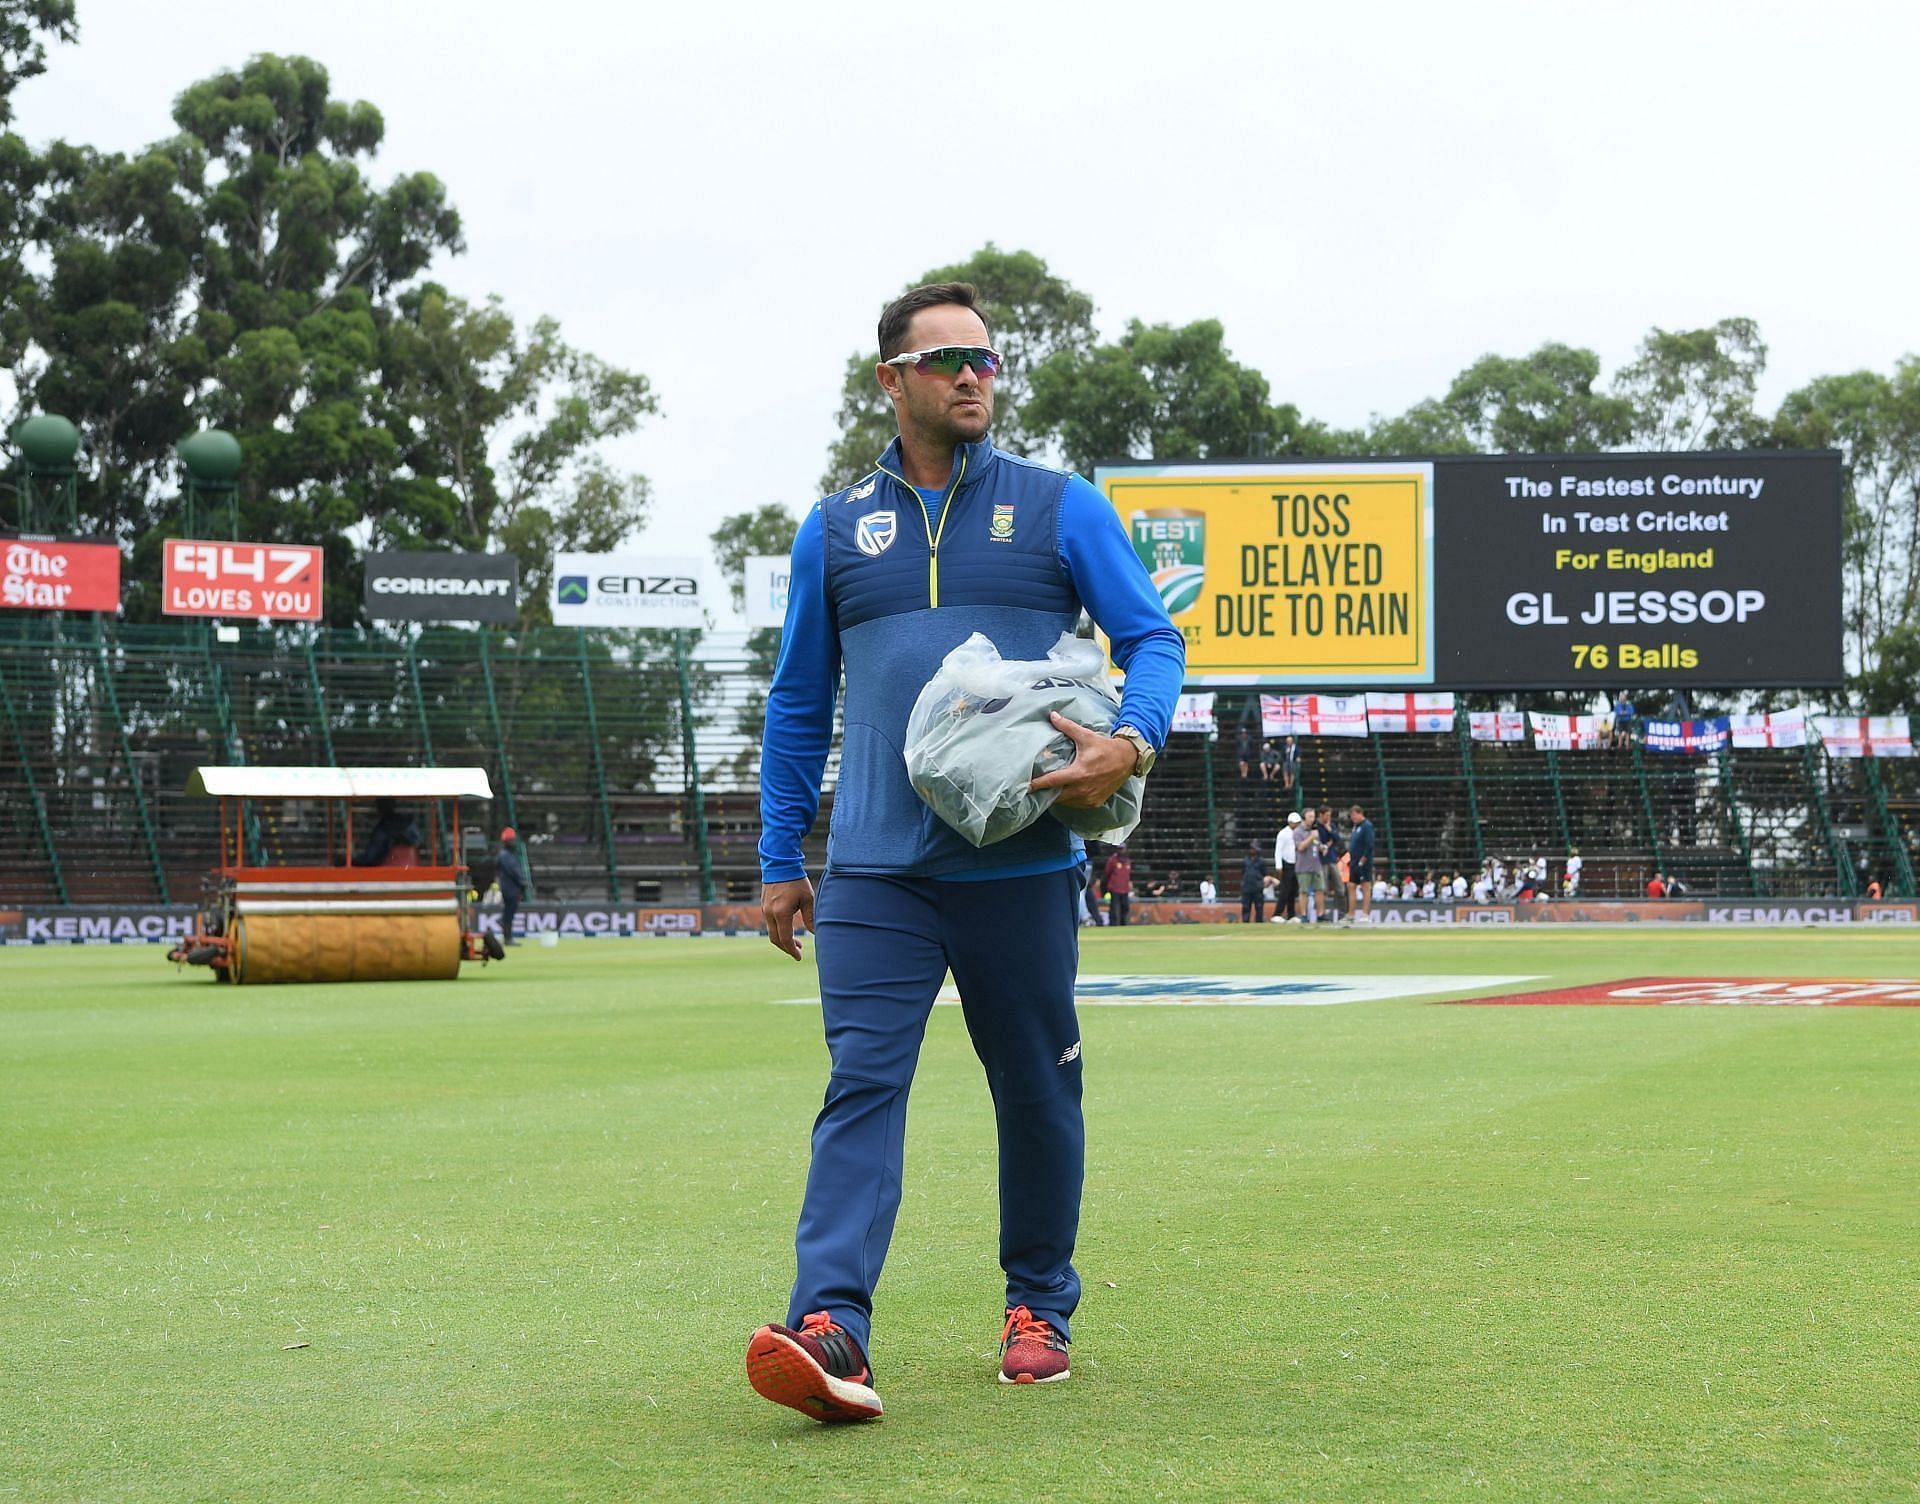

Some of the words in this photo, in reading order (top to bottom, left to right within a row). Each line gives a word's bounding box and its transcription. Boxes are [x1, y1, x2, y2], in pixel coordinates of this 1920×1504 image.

[1505, 476, 1552, 497] The
[1560, 476, 1655, 497] Fastest
[1661, 474, 1765, 499] Century
[1271, 494, 1351, 538] TOSS
[1542, 513, 1567, 533] In
[1574, 511, 1630, 533] Test
[1636, 510, 1729, 532] Cricket
[1135, 520, 1201, 544] TEST
[5, 543, 68, 578] The
[174, 545, 312, 584] 947
[1241, 543, 1383, 588] DELAYED
[1555, 549, 1600, 570] For
[1606, 548, 1714, 574] England
[2, 573, 72, 607] Star
[173, 586, 253, 612] LOVES
[262, 590, 312, 613] YOU
[372, 576, 511, 597] CORICRAFT
[596, 596, 700, 608] CONSTRUCTION
[1215, 593, 1275, 637] DUE
[1285, 593, 1323, 637] TO
[1335, 592, 1409, 636] RAIN
[1506, 591, 1570, 625] GL
[1581, 590, 1766, 625] JESSOP
[1570, 644, 1610, 670] 76
[1618, 643, 1699, 669] Balls
[26, 916, 193, 937] KEMACH
[478, 912, 636, 932] KEMACH
[644, 913, 697, 928] JCB
[1465, 909, 1511, 923] JCB
[1708, 908, 1851, 922] KEMACH
[1864, 909, 1912, 922] JCB
